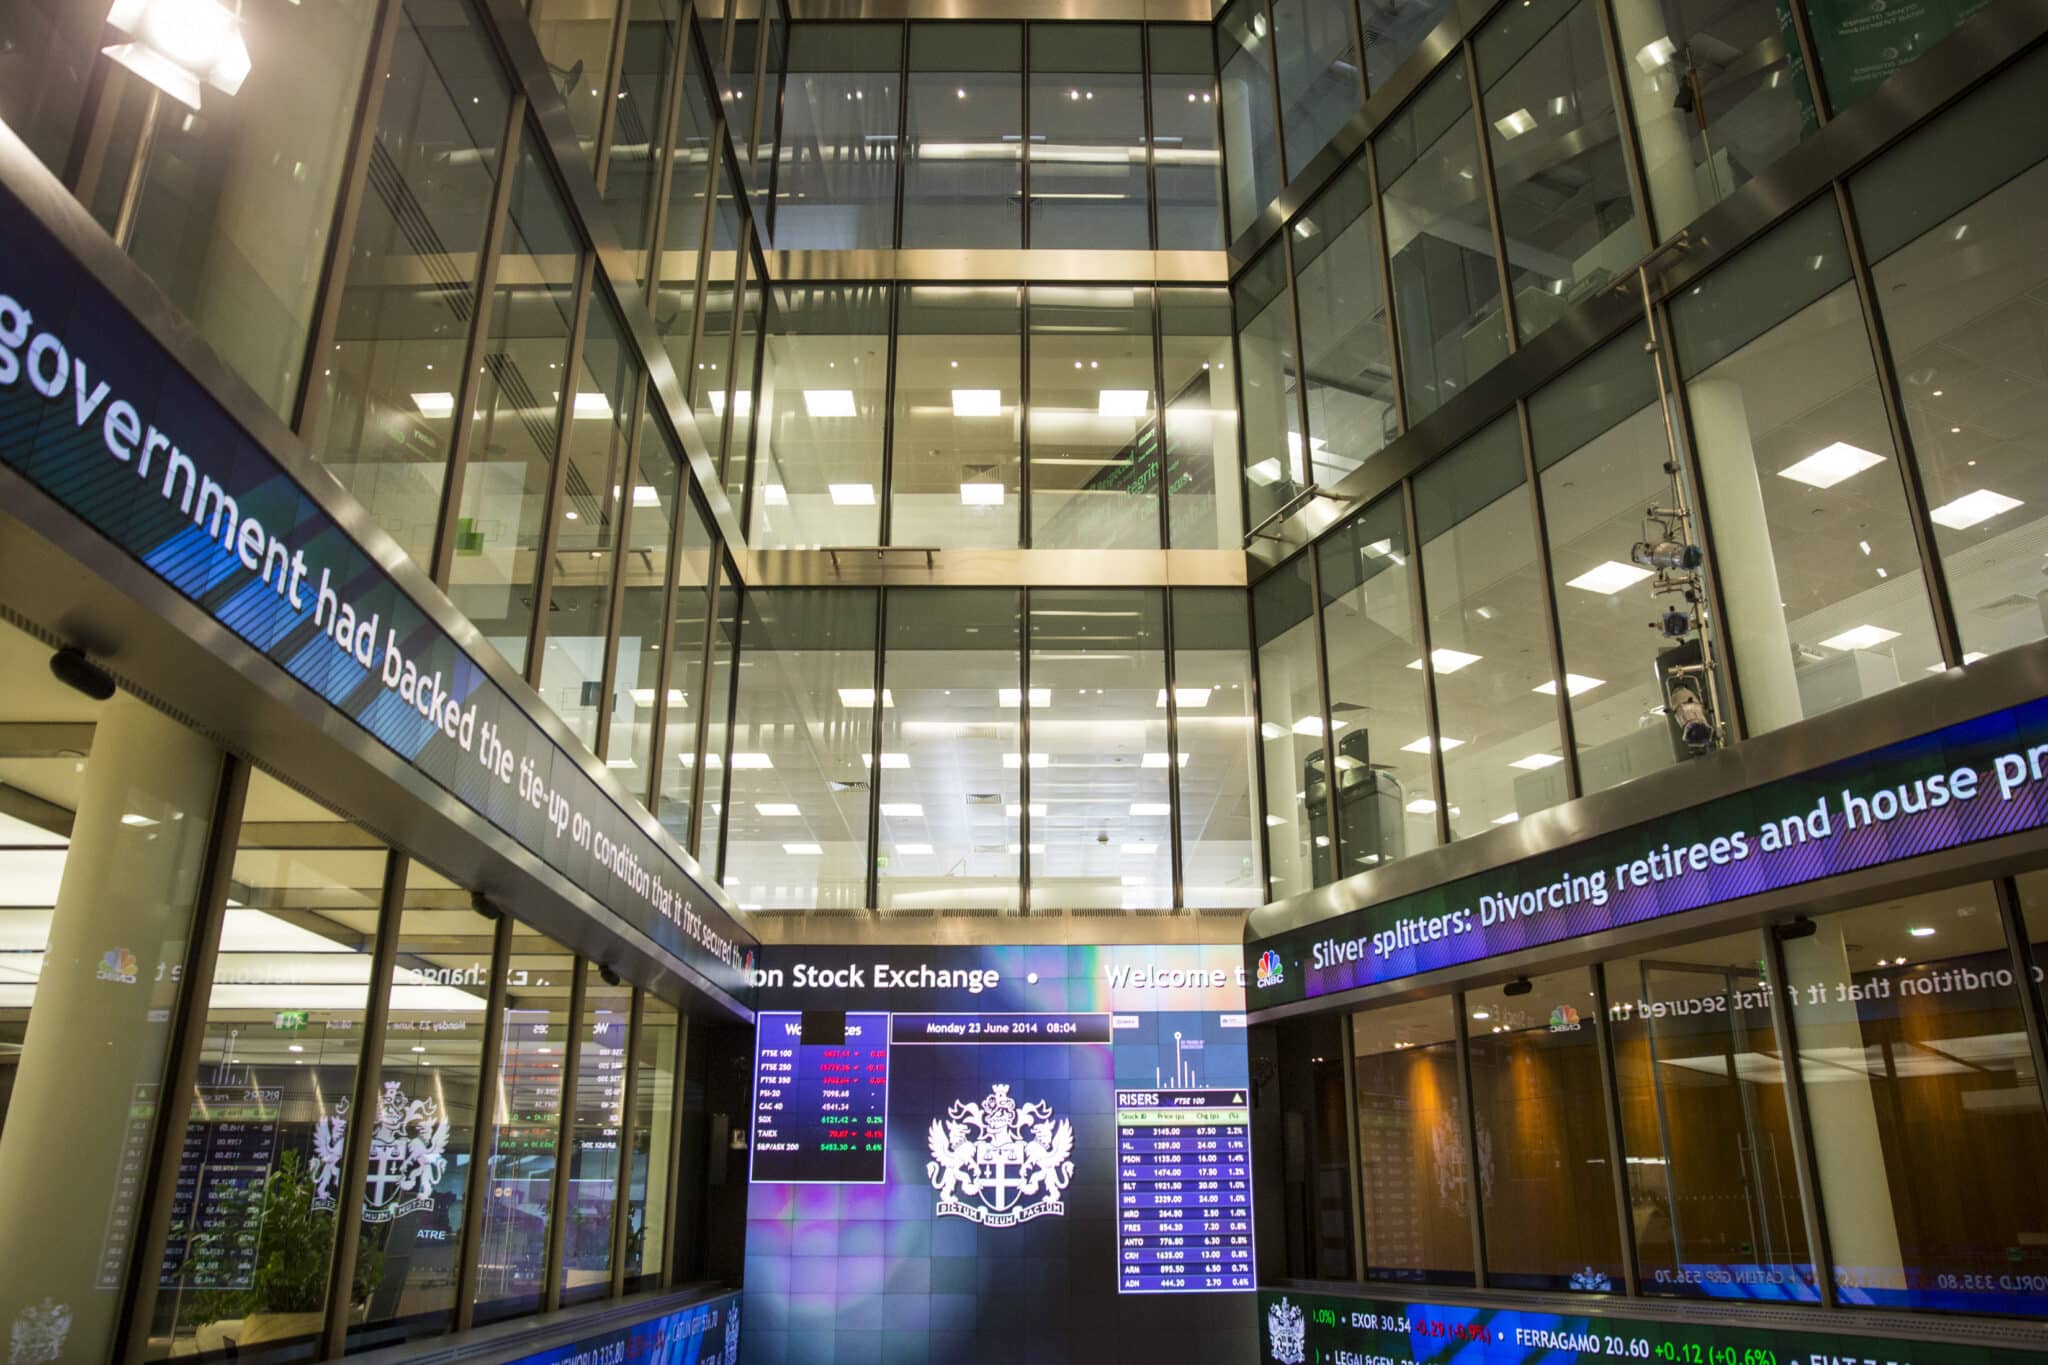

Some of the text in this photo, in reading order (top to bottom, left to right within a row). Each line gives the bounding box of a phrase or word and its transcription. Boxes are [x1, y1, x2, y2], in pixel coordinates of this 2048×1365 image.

[0, 294, 307, 610] government
[314, 568, 379, 669] had
[381, 628, 477, 753] backed
[479, 721, 514, 785] the
[518, 756, 569, 838] tie-up
[572, 813, 591, 851] on
[594, 831, 650, 900] condition
[651, 875, 674, 919] that
[673, 894, 683, 926] it
[683, 903, 702, 947] first
[701, 923, 732, 966] secured
[1312, 937, 1368, 970] Silver
[1373, 908, 1472, 960] splitters:
[1479, 868, 1606, 927] Divorcing
[1615, 829, 1749, 891] retirees
[1760, 798, 1833, 852] and
[1842, 765, 1978, 830] house
[792, 964, 865, 988] Stock
[874, 964, 1000, 993] Exchange
[1104, 964, 1227, 989] Welcome
[1257, 974, 1284, 988] CNBC
[926, 1022, 1077, 1036] Monday 23 June 2014 08:04
[1119, 1093, 1159, 1105] RISERS
[1174, 1097, 1191, 1105] FTSE
[1351, 1312, 1379, 1331] EXOR
[1381, 1316, 1411, 1333] 30.54
[1415, 1319, 1445, 1338] -0.29
[1515, 1327, 1600, 1354] FERRAGAMO
[1605, 1335, 1649, 1358] 20.60
[1655, 1341, 1702, 1365] +0.12
